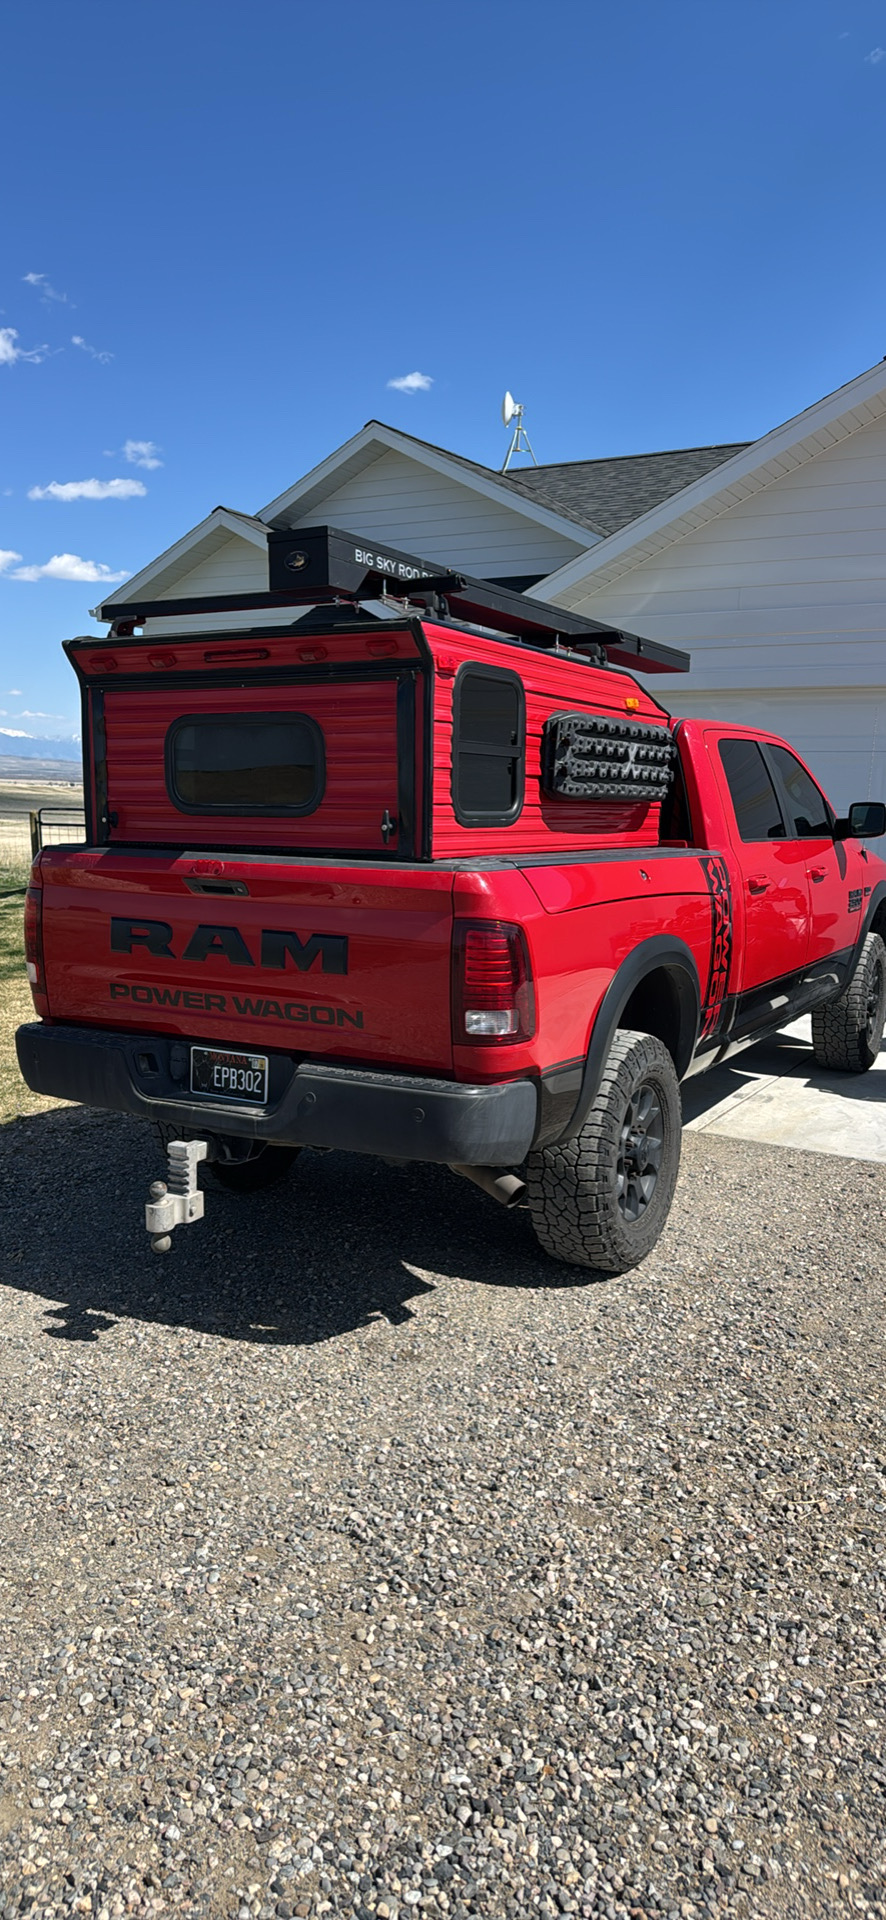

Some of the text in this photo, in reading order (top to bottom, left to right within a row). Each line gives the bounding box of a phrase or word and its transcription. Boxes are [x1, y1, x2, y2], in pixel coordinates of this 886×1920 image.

[355, 549, 374, 566] BIG
[376, 556, 396, 574] SKY
[398, 563, 420, 579] ROD
[110, 916, 349, 976] RAM
[701, 858, 723, 1037] WAGON
[709, 858, 730, 1035] POWER
[109, 983, 365, 1029] POWER WAGON
[214, 1065, 262, 1093] EPB302
